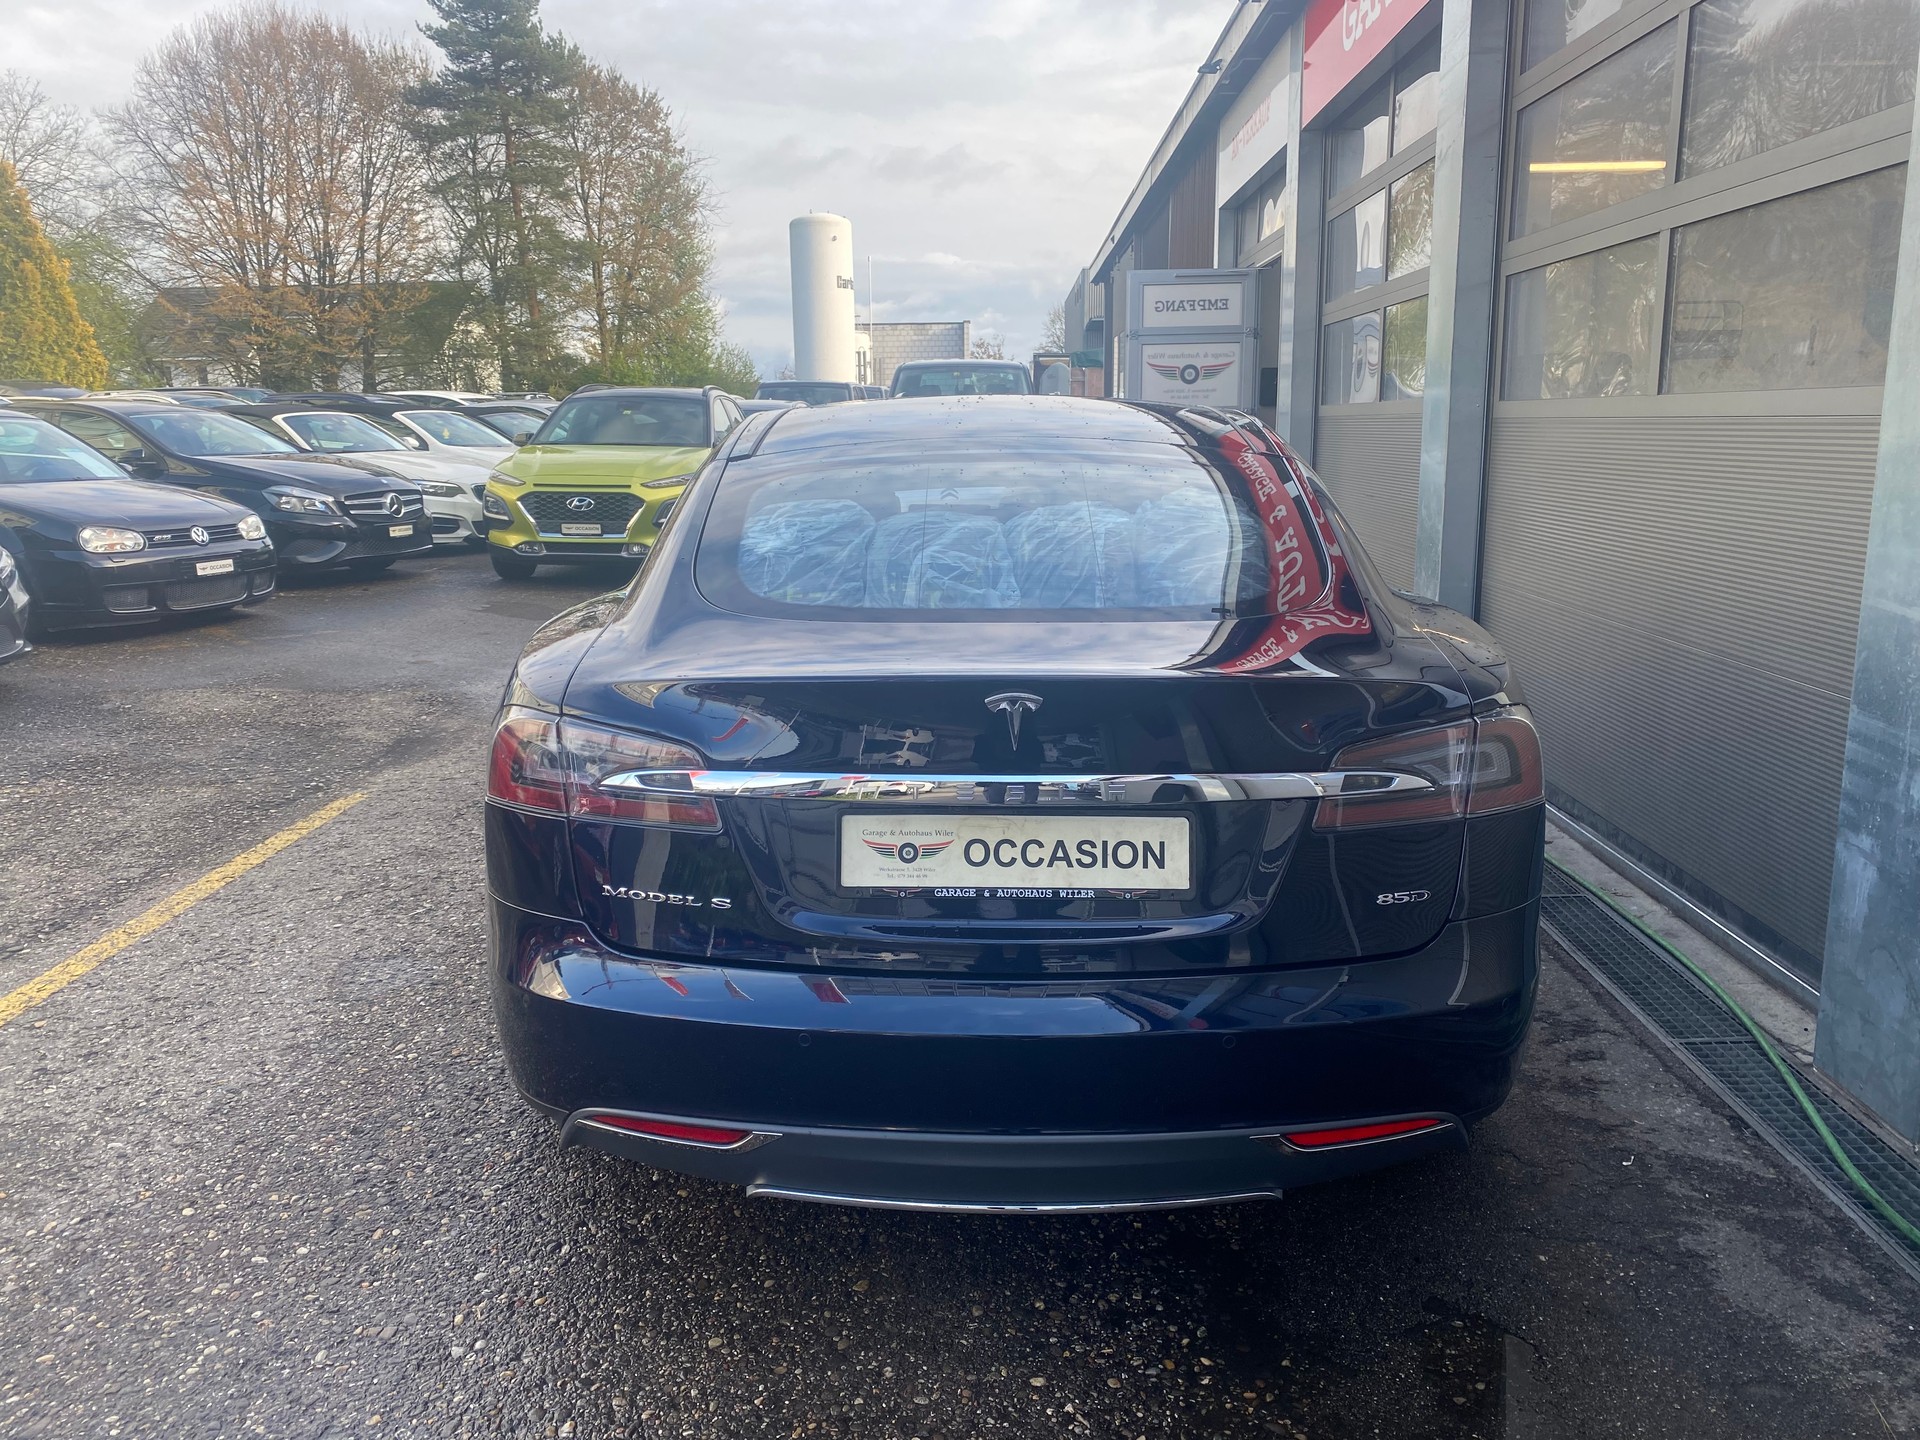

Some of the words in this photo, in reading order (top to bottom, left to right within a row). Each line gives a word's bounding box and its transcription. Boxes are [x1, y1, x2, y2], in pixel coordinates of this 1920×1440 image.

[209, 563, 233, 571] OCCASION
[862, 829, 888, 838] Garage
[889, 829, 896, 837] &
[898, 829, 933, 837] Autohaus
[934, 829, 954, 837] Wiler
[963, 838, 1166, 870] OCCASION
[602, 885, 703, 907] MODEL
[711, 897, 732, 909] S
[934, 888, 977, 897] GARAGE
[983, 889, 990, 897] &
[996, 888, 1053, 898] AUTOHAUS
[1059, 890, 1096, 898] WILER
[1376, 890, 1432, 905] 85D
